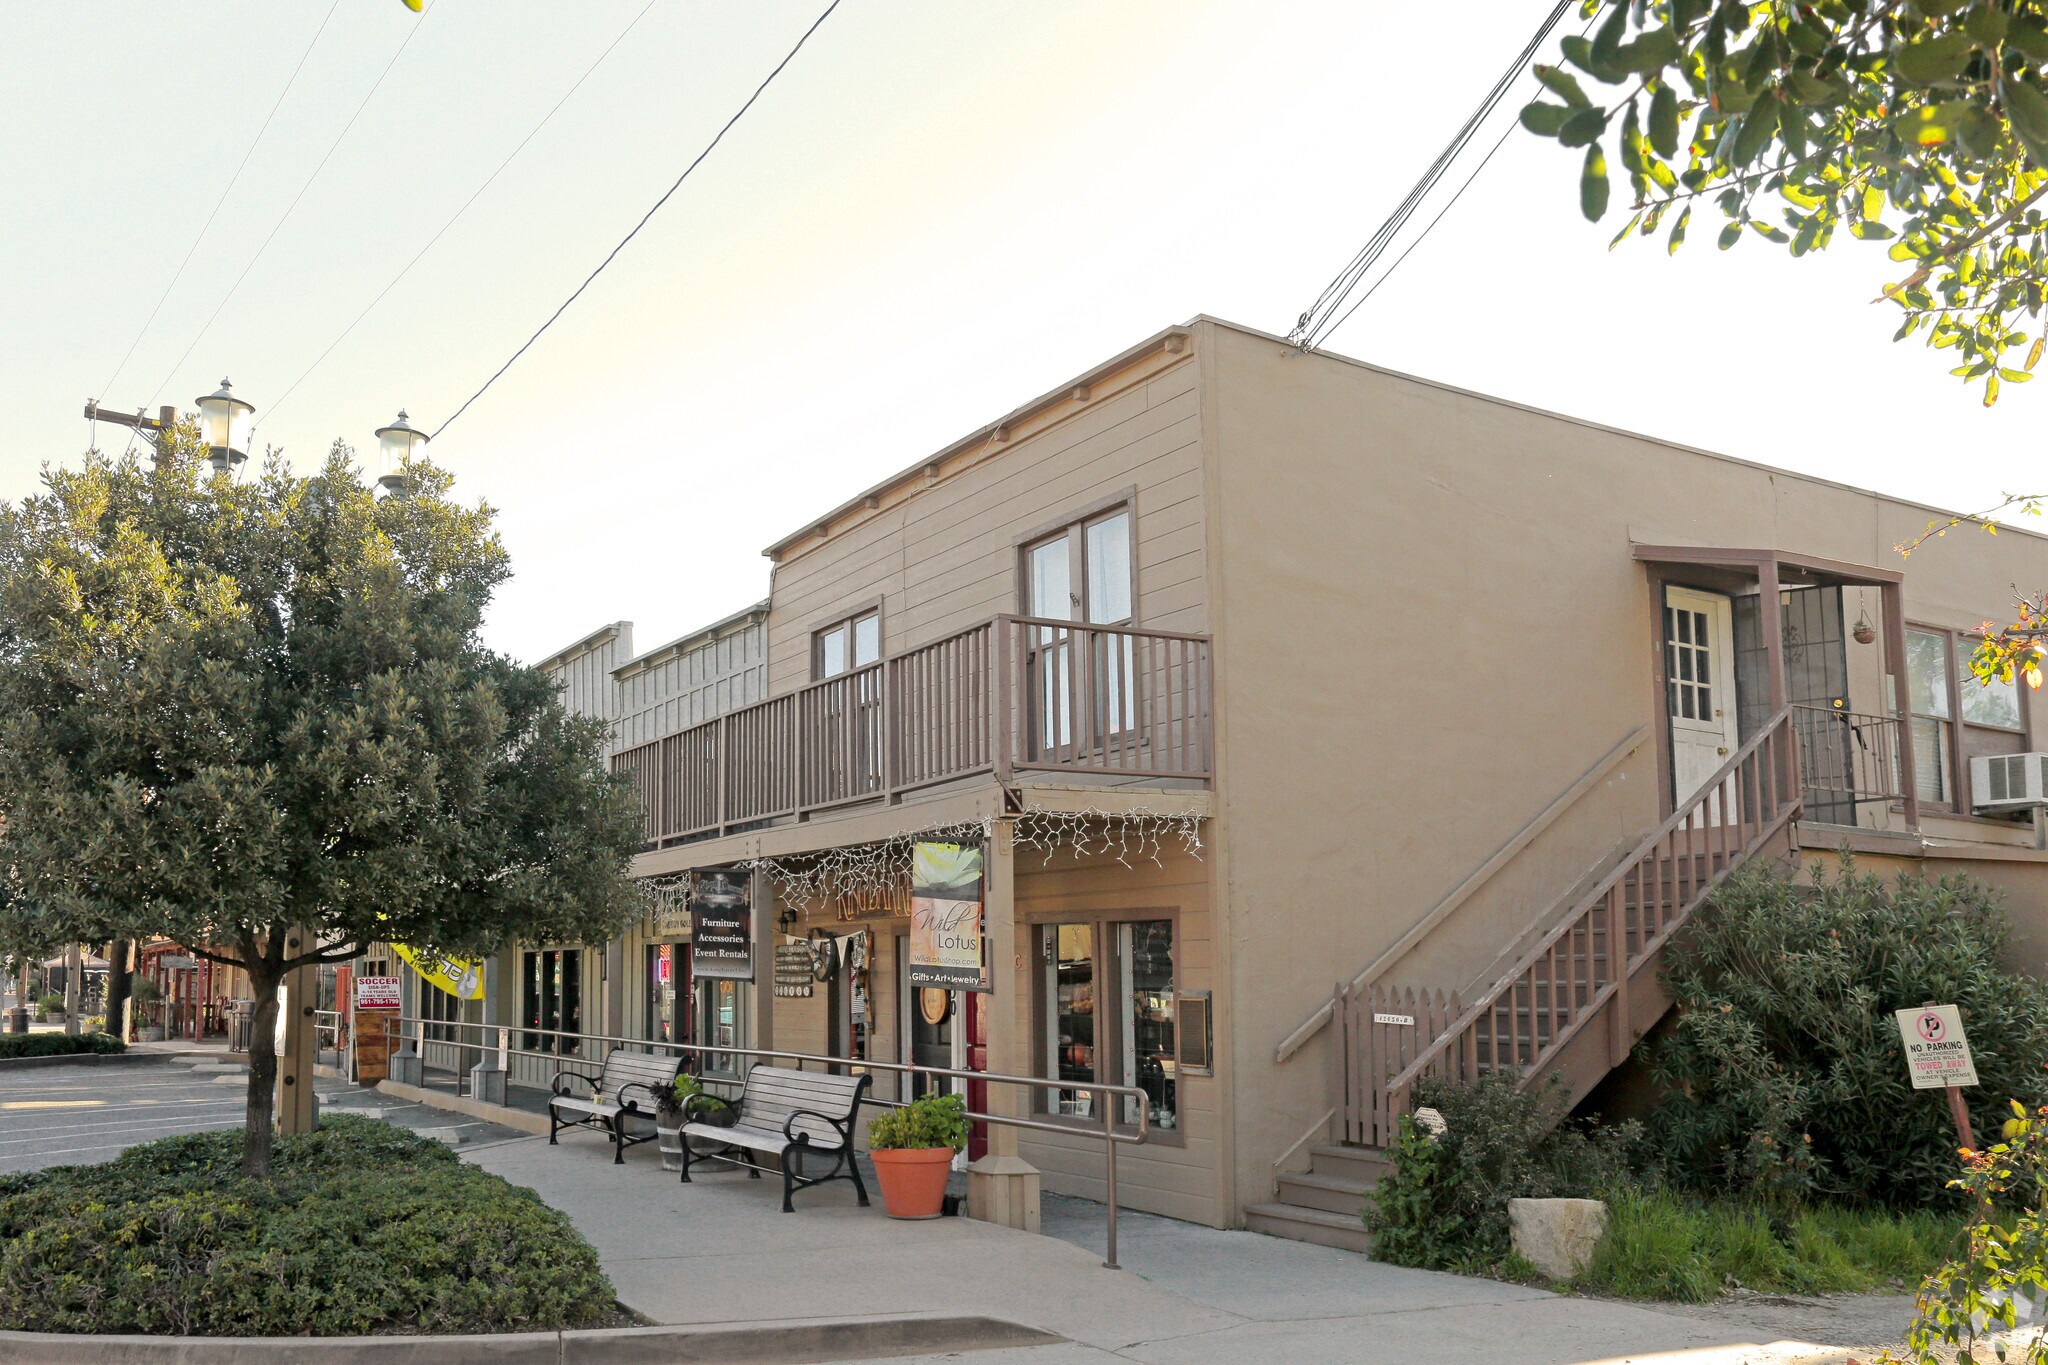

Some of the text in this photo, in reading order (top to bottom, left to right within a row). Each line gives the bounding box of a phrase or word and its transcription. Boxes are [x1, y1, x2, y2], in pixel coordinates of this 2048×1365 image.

[914, 901, 979, 932] Wild
[702, 918, 740, 928] Furniture
[698, 933, 744, 943] Accessories
[938, 934, 976, 950] Lotus
[695, 948, 748, 959] Event Rentals
[912, 972, 930, 982] Gifts
[1910, 1041, 1963, 1053] NO PARKING
[1915, 1060, 1966, 1070] TOWED AWAY
